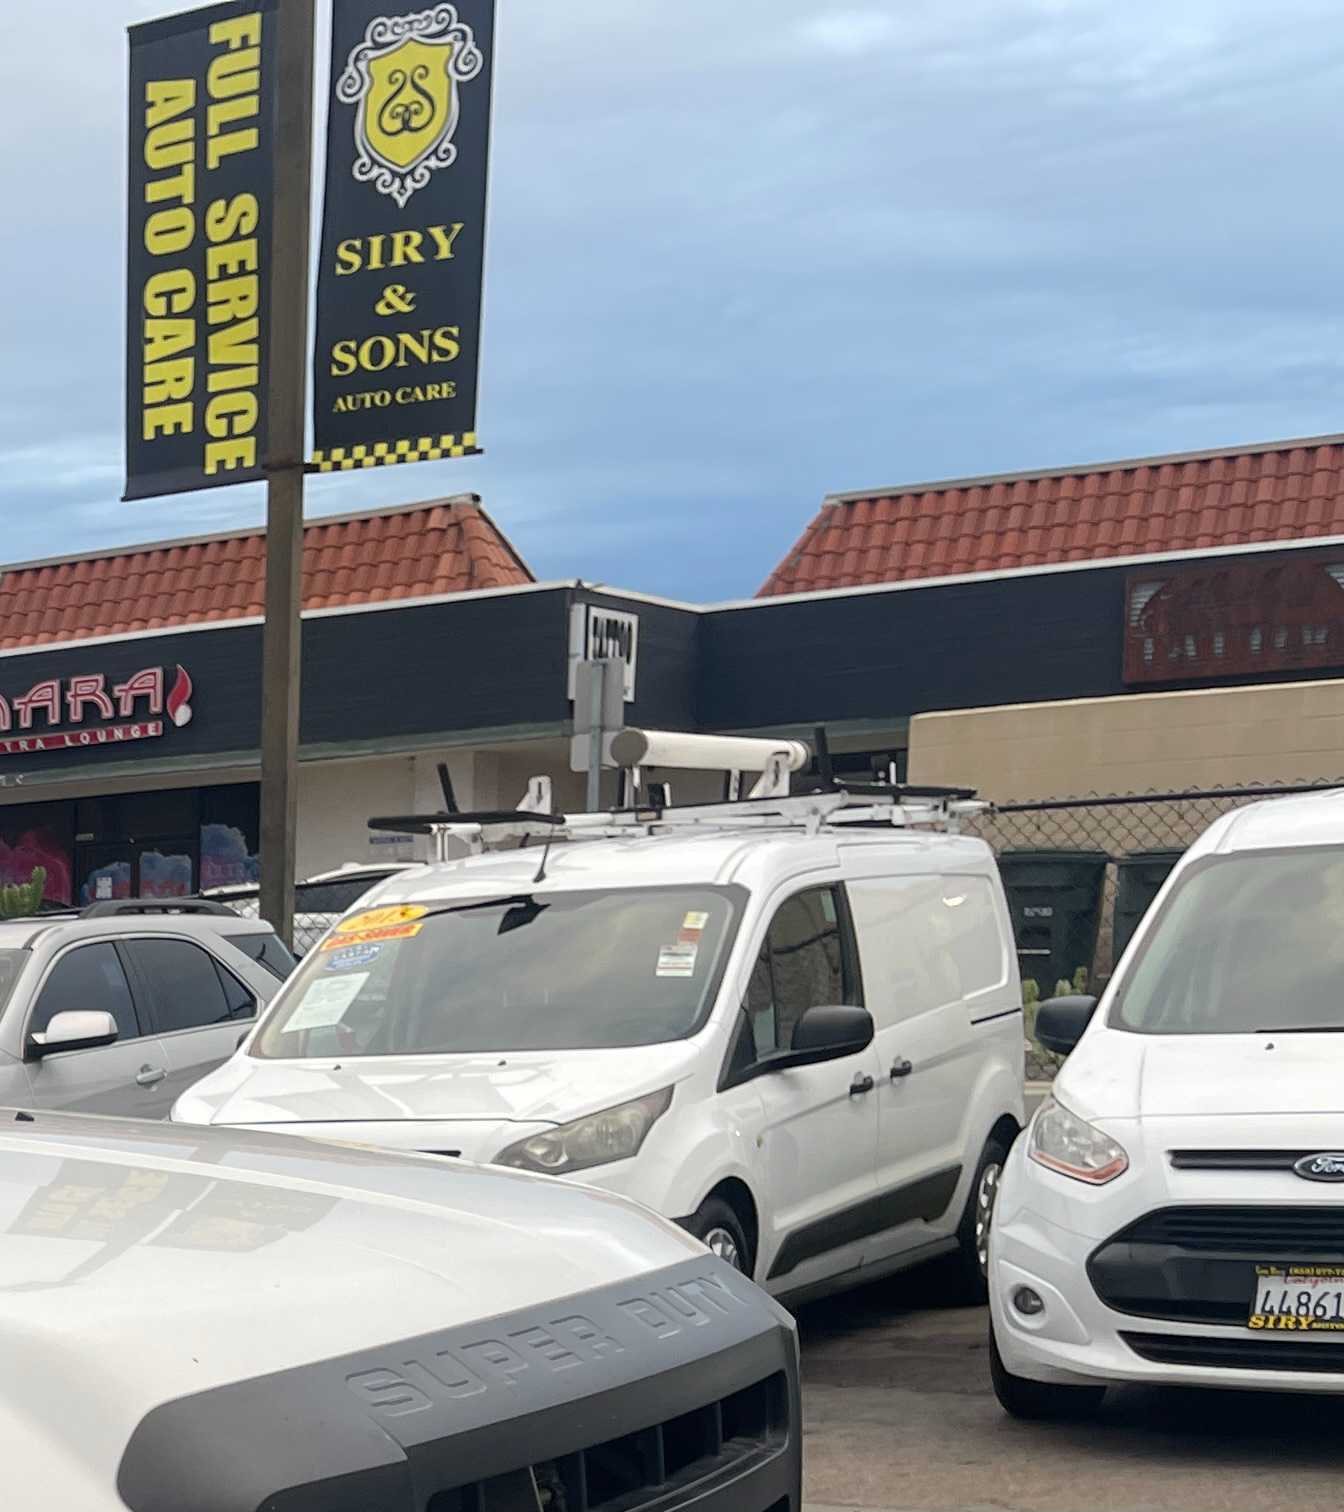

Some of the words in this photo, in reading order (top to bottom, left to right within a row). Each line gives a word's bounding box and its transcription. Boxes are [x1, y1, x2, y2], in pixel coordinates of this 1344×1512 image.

[206, 11, 262, 169] FULL
[143, 78, 197, 256] AUTO
[335, 222, 464, 276] SIRY
[203, 193, 259, 475] SERVICE
[375, 284, 417, 316] &
[143, 267, 196, 441] CARE
[330, 326, 460, 376] SONS
[333, 390, 392, 413] AUTO
[395, 380, 457, 404] CARE
[65, 723, 158, 747] LOUNGE
[345, 1314, 625, 1417] SUPER
[616, 1273, 750, 1340] DUTY
